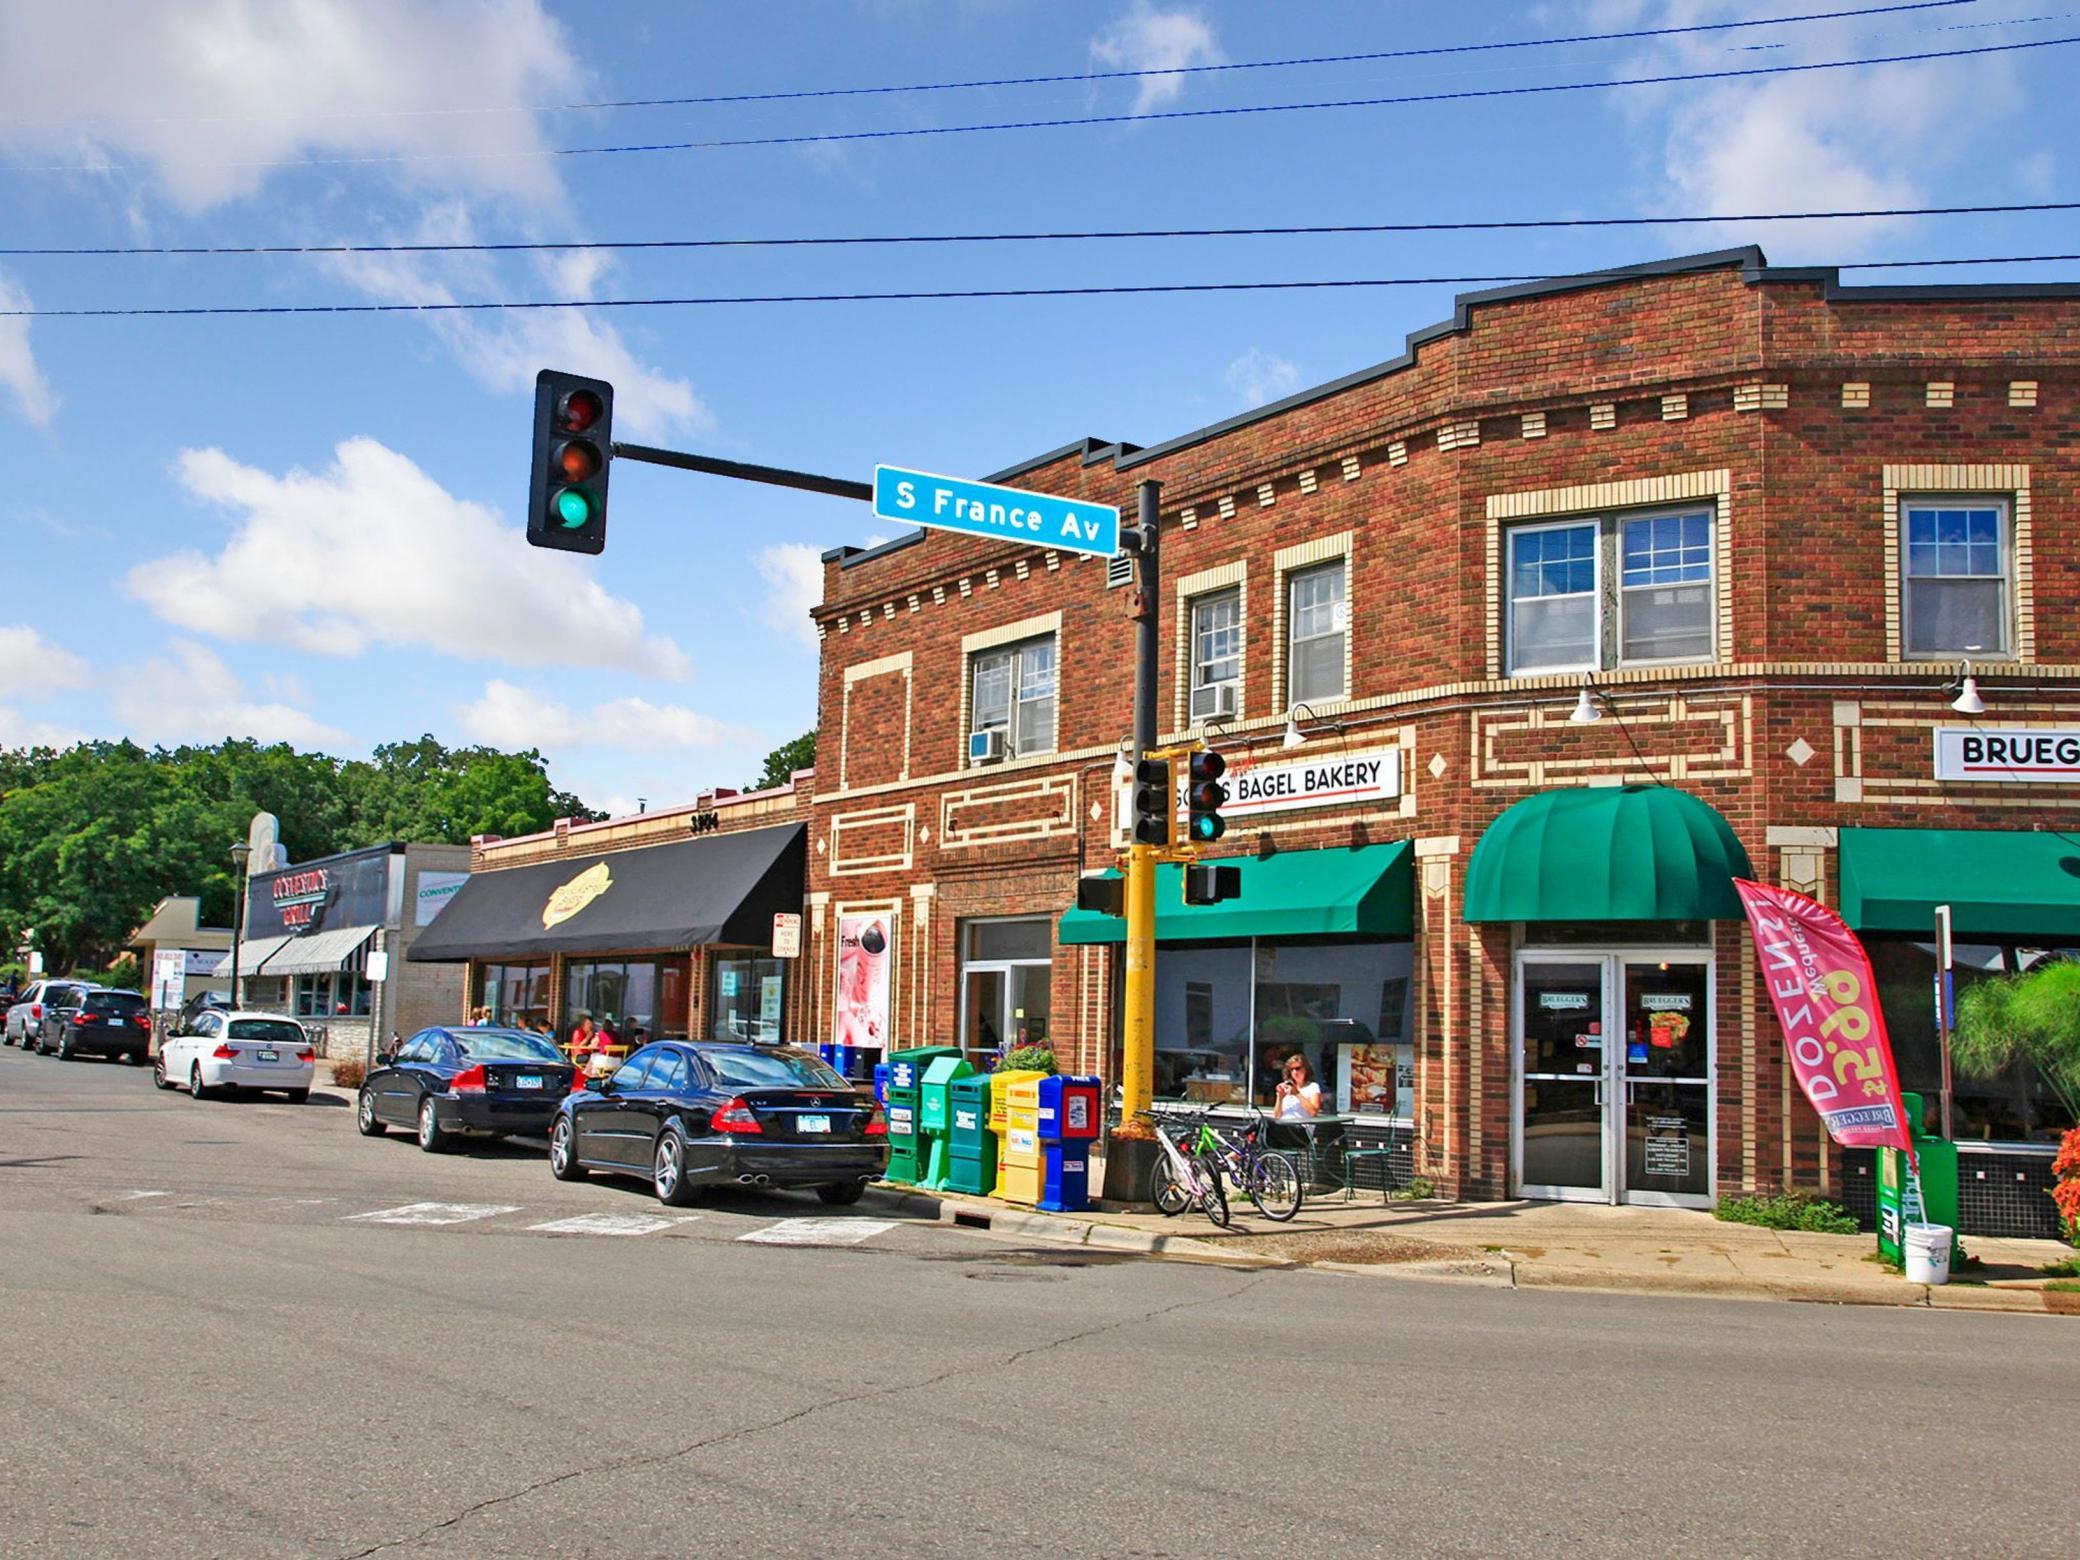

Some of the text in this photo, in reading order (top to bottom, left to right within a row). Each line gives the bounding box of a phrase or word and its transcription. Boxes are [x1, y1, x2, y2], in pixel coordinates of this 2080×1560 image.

[896, 482, 1100, 541] S France Av
[1963, 737, 2080, 765] BRUEG
[1239, 772, 1296, 800] BAGEL
[1305, 760, 1382, 792] BAKERY
[841, 935, 860, 947] Fresh
[1903, 1151, 1921, 1222] Tribune
